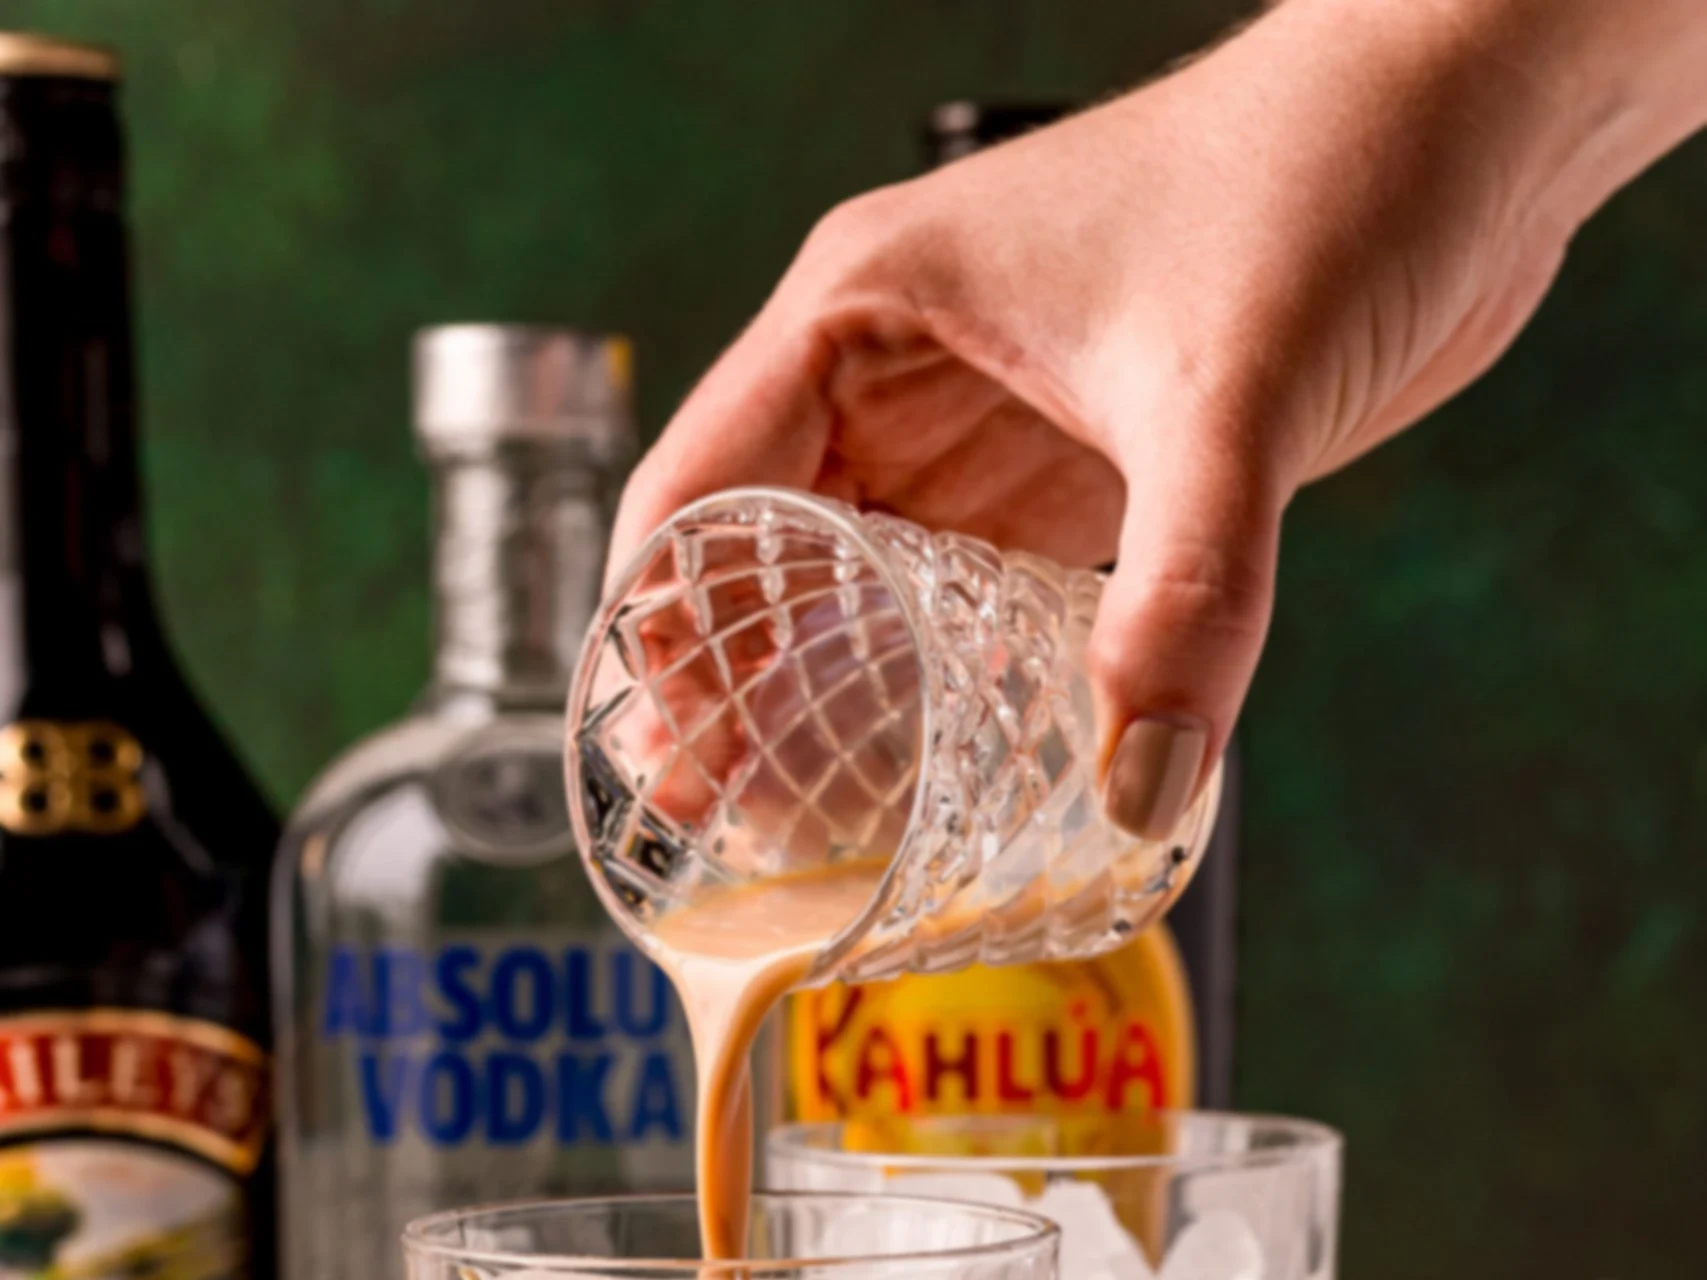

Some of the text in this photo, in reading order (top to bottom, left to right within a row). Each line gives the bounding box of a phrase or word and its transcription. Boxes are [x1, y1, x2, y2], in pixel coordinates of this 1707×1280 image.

[324, 945, 667, 1040] ABSOLU
[0, 1034, 248, 1131] ILEYS
[816, 985, 1166, 1114] KAHLÚA
[357, 1052, 684, 1147] VODKA
